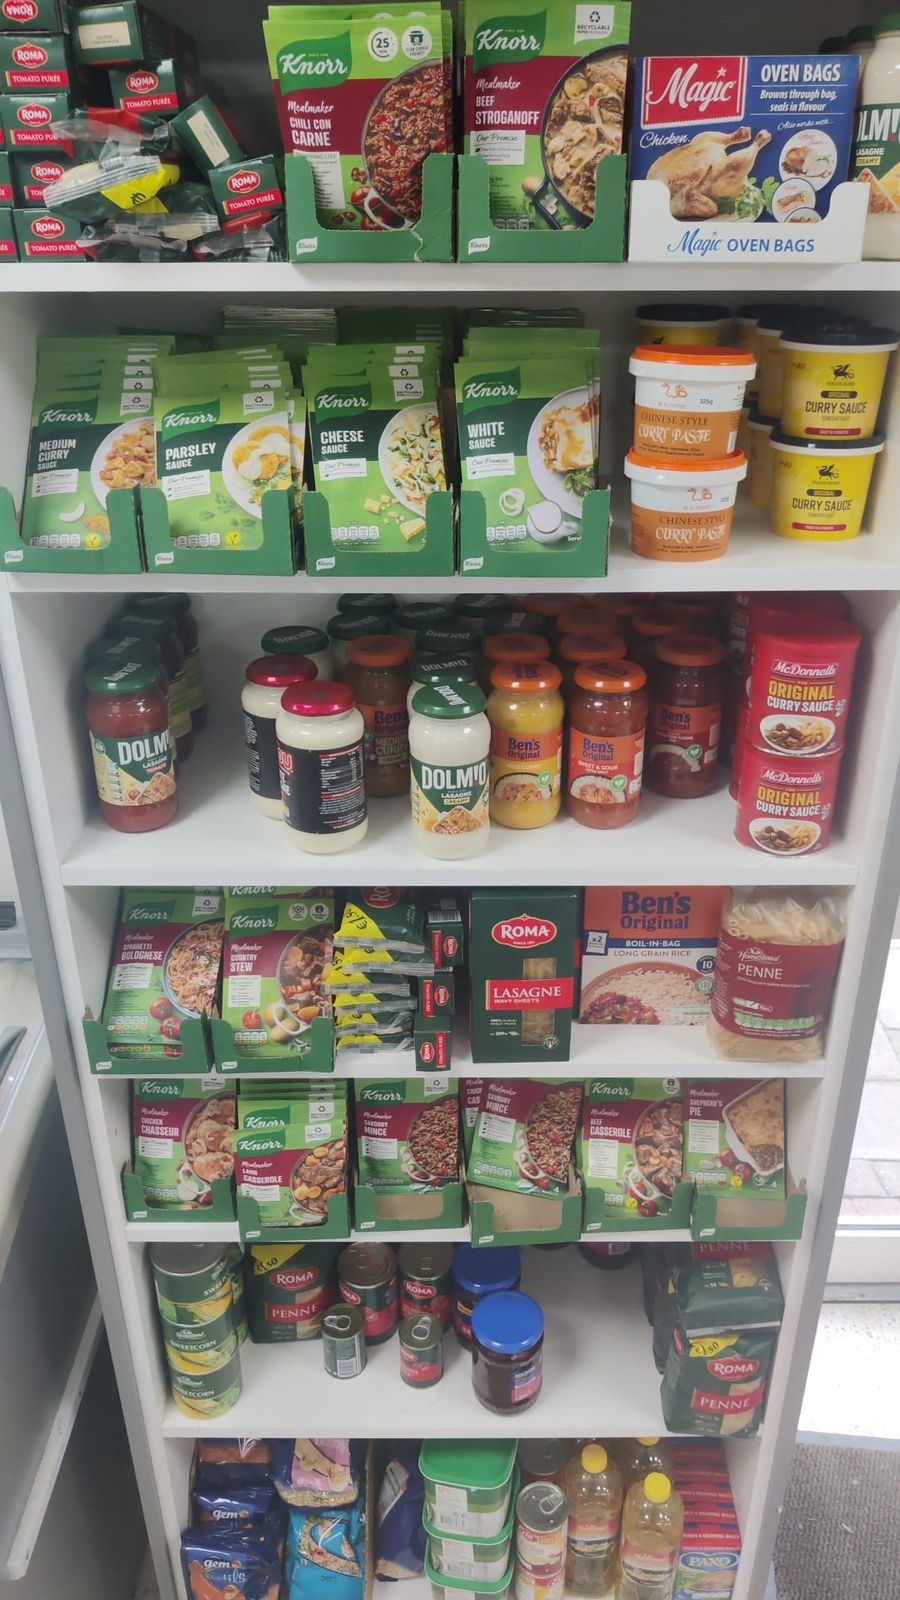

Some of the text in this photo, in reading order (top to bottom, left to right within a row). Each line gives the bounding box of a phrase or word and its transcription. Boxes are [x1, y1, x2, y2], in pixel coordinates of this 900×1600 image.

[376, 37, 389, 48] 25
[477, 29, 540, 51] Knorr
[17, 50, 44, 62] ROMA
[279, 53, 347, 75] Knorr
[12, 74, 40, 83] TOMATO
[761, 64, 840, 82] OVEN BAGS
[129, 76, 154, 87] ROMA
[476, 76, 520, 90] Mealmaker
[646, 63, 734, 111] Magic
[476, 96, 494, 107] BEEF
[760, 90, 837, 101] Browns through bag,
[126, 100, 150, 109] TOMATO
[287, 101, 333, 113] Mealmaker
[770, 103, 826, 112] seals in flavour
[20, 110, 48, 120] ROMA
[475, 111, 540, 125] STROGANOFF
[290, 118, 331, 130] CHILI CON
[778, 121, 796, 131] Also
[17, 133, 43, 142] TOMATO
[292, 131, 330, 146] CARNE
[490, 134, 519, 142] Promise
[34, 166, 61, 177] ROMA
[231, 175, 257, 188] ROMA
[229, 198, 255, 210] TOMATO
[34, 221, 61, 232] ROMA
[31, 244, 56, 252] TOMATO
[667, 229, 815, 256] Magic OVEN BAGS
[464, 382, 518, 399] Knorr
[316, 394, 369, 409] Knorr
[805, 401, 867, 414] CURRY SAUCE
[42, 409, 91, 423] Knorr
[164, 413, 217, 428] Knorr
[641, 413, 709, 426] CHINESE STYLE
[467, 422, 505, 438] WHITE
[638, 426, 711, 444] CURRY PASTE
[320, 430, 364, 445] CHEESE
[39, 439, 76, 451] MEDIUM
[321, 444, 348, 454] SAUCE
[469, 438, 496, 450] SAUCE
[38, 450, 69, 463] CURRY
[166, 443, 216, 460] PARSLEY
[37, 461, 57, 470] SAUCE
[166, 459, 192, 470] SAUCE
[472, 458, 484, 466] Our
[792, 498, 852, 511] CURRY SAUCE
[659, 516, 702, 525] CHINESE
[656, 526, 697, 541] CURRY
[775, 661, 838, 678] McDonnells
[769, 682, 835, 700] ORIGINAL
[767, 695, 833, 713] CURRY SAUCE
[660, 708, 691, 723] Ben's
[508, 738, 540, 751] Ben's
[583, 738, 615, 753] Ben's
[508, 750, 540, 761] Original
[582, 749, 614, 762] Original
[142, 756, 167, 769] LASAGNE
[578, 760, 595, 769] SWEET
[763, 768, 822, 784] McDonnells
[441, 791, 472, 799] LASAGNE
[757, 787, 821, 806] ORIGINAL
[756, 801, 820, 818] CURRY SAUCE
[621, 891, 690, 915] Ben's
[128, 908, 170, 920] Knorr
[232, 915, 275, 929] Knorr
[620, 915, 689, 931] Original
[501, 925, 549, 939] ROMA
[592, 936, 603, 944] x2
[123, 943, 152, 951] SPAGHETTI
[230, 943, 262, 952] Mealmaker
[121, 951, 162, 961] BOLOGNESE
[230, 962, 253, 972] STEW
[702, 961, 713, 969] 10
[737, 963, 783, 980] PENNE
[438, 988, 446, 1004] ROMA
[493, 986, 561, 998] LASAGNE
[141, 1081, 181, 1095] Knorr
[591, 1082, 631, 1096] Knorr
[362, 1089, 403, 1101] Knorr
[488, 1092, 511, 1104] SAVOURY
[486, 1102, 509, 1114] MINCE
[690, 1099, 723, 1107] SHEPHERD'S
[690, 1106, 702, 1117] PIE
[141, 1118, 163, 1126] CHICKEN
[244, 1116, 285, 1128] Knorr
[364, 1120, 388, 1128] SAVOURY
[591, 1118, 602, 1126] BEEF
[141, 1125, 179, 1137] CHASSEUR
[364, 1127, 387, 1136] MINCE
[590, 1126, 631, 1138] CASSEROLE
[238, 1140, 283, 1151] Knorr
[244, 1175, 282, 1184] CASSEROLE
[277, 1273, 314, 1285] ROMA
[406, 1283, 433, 1294] ROMA
[272, 1303, 319, 1318] PENNE
[714, 1362, 753, 1374] ROMA
[700, 1397, 749, 1409] PENNE
[213, 1508, 238, 1521] gem
[204, 1559, 230, 1571] gem
[688, 1556, 731, 1567] PAXO
